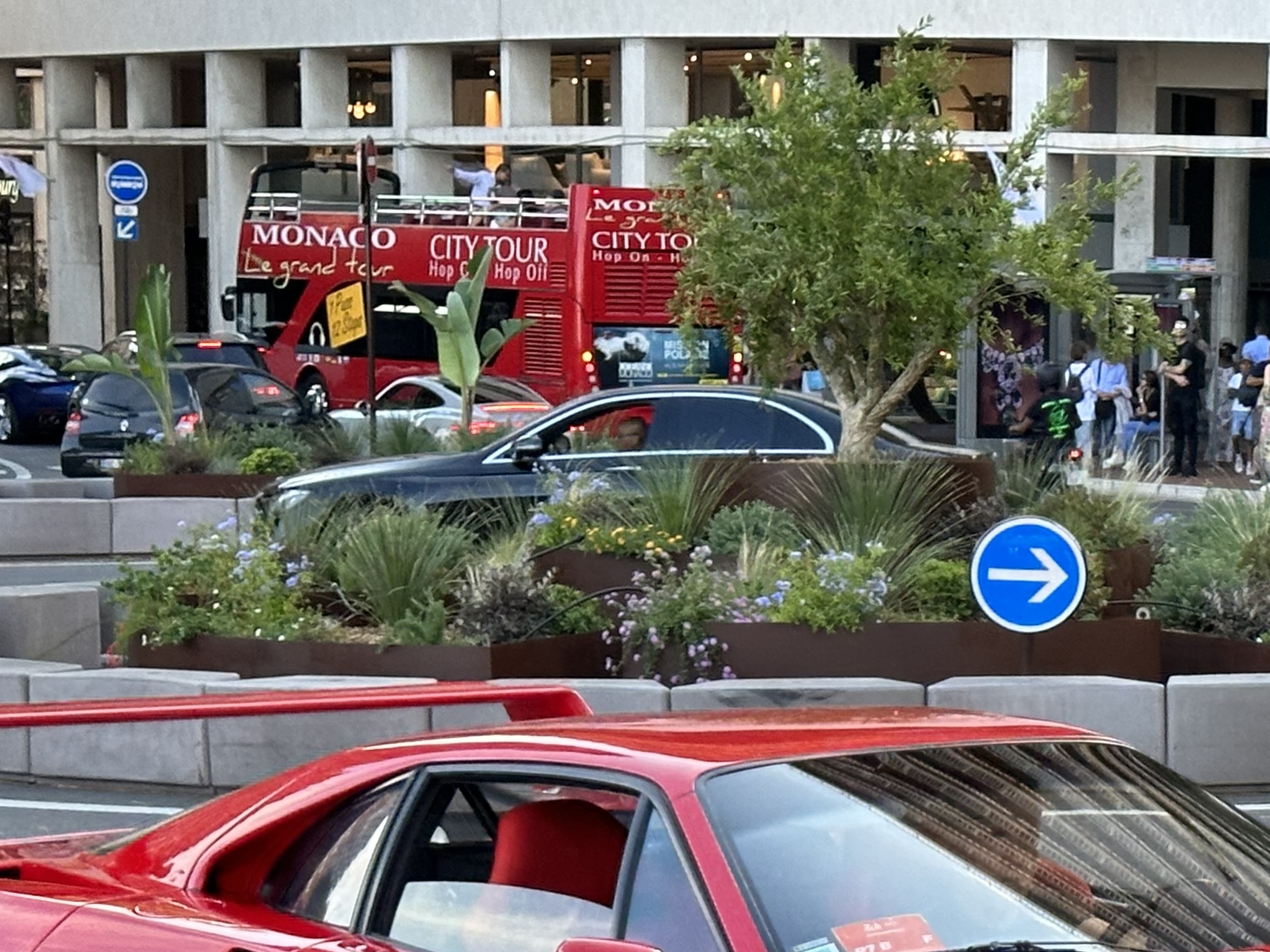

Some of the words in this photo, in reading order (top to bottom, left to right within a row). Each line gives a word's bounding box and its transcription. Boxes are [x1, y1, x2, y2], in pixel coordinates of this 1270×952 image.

[252, 224, 396, 249] MONACO
[430, 234, 479, 261] CITY
[483, 236, 548, 264] TOUR
[592, 231, 651, 250] CITY
[244, 247, 272, 272] Le
[273, 245, 336, 289] grand
[345, 246, 395, 277] tour
[592, 250, 622, 263] Hop
[629, 252, 650, 263] On
[429, 260, 454, 281] Hop
[494, 263, 520, 285] Hop
[526, 263, 549, 282] Off
